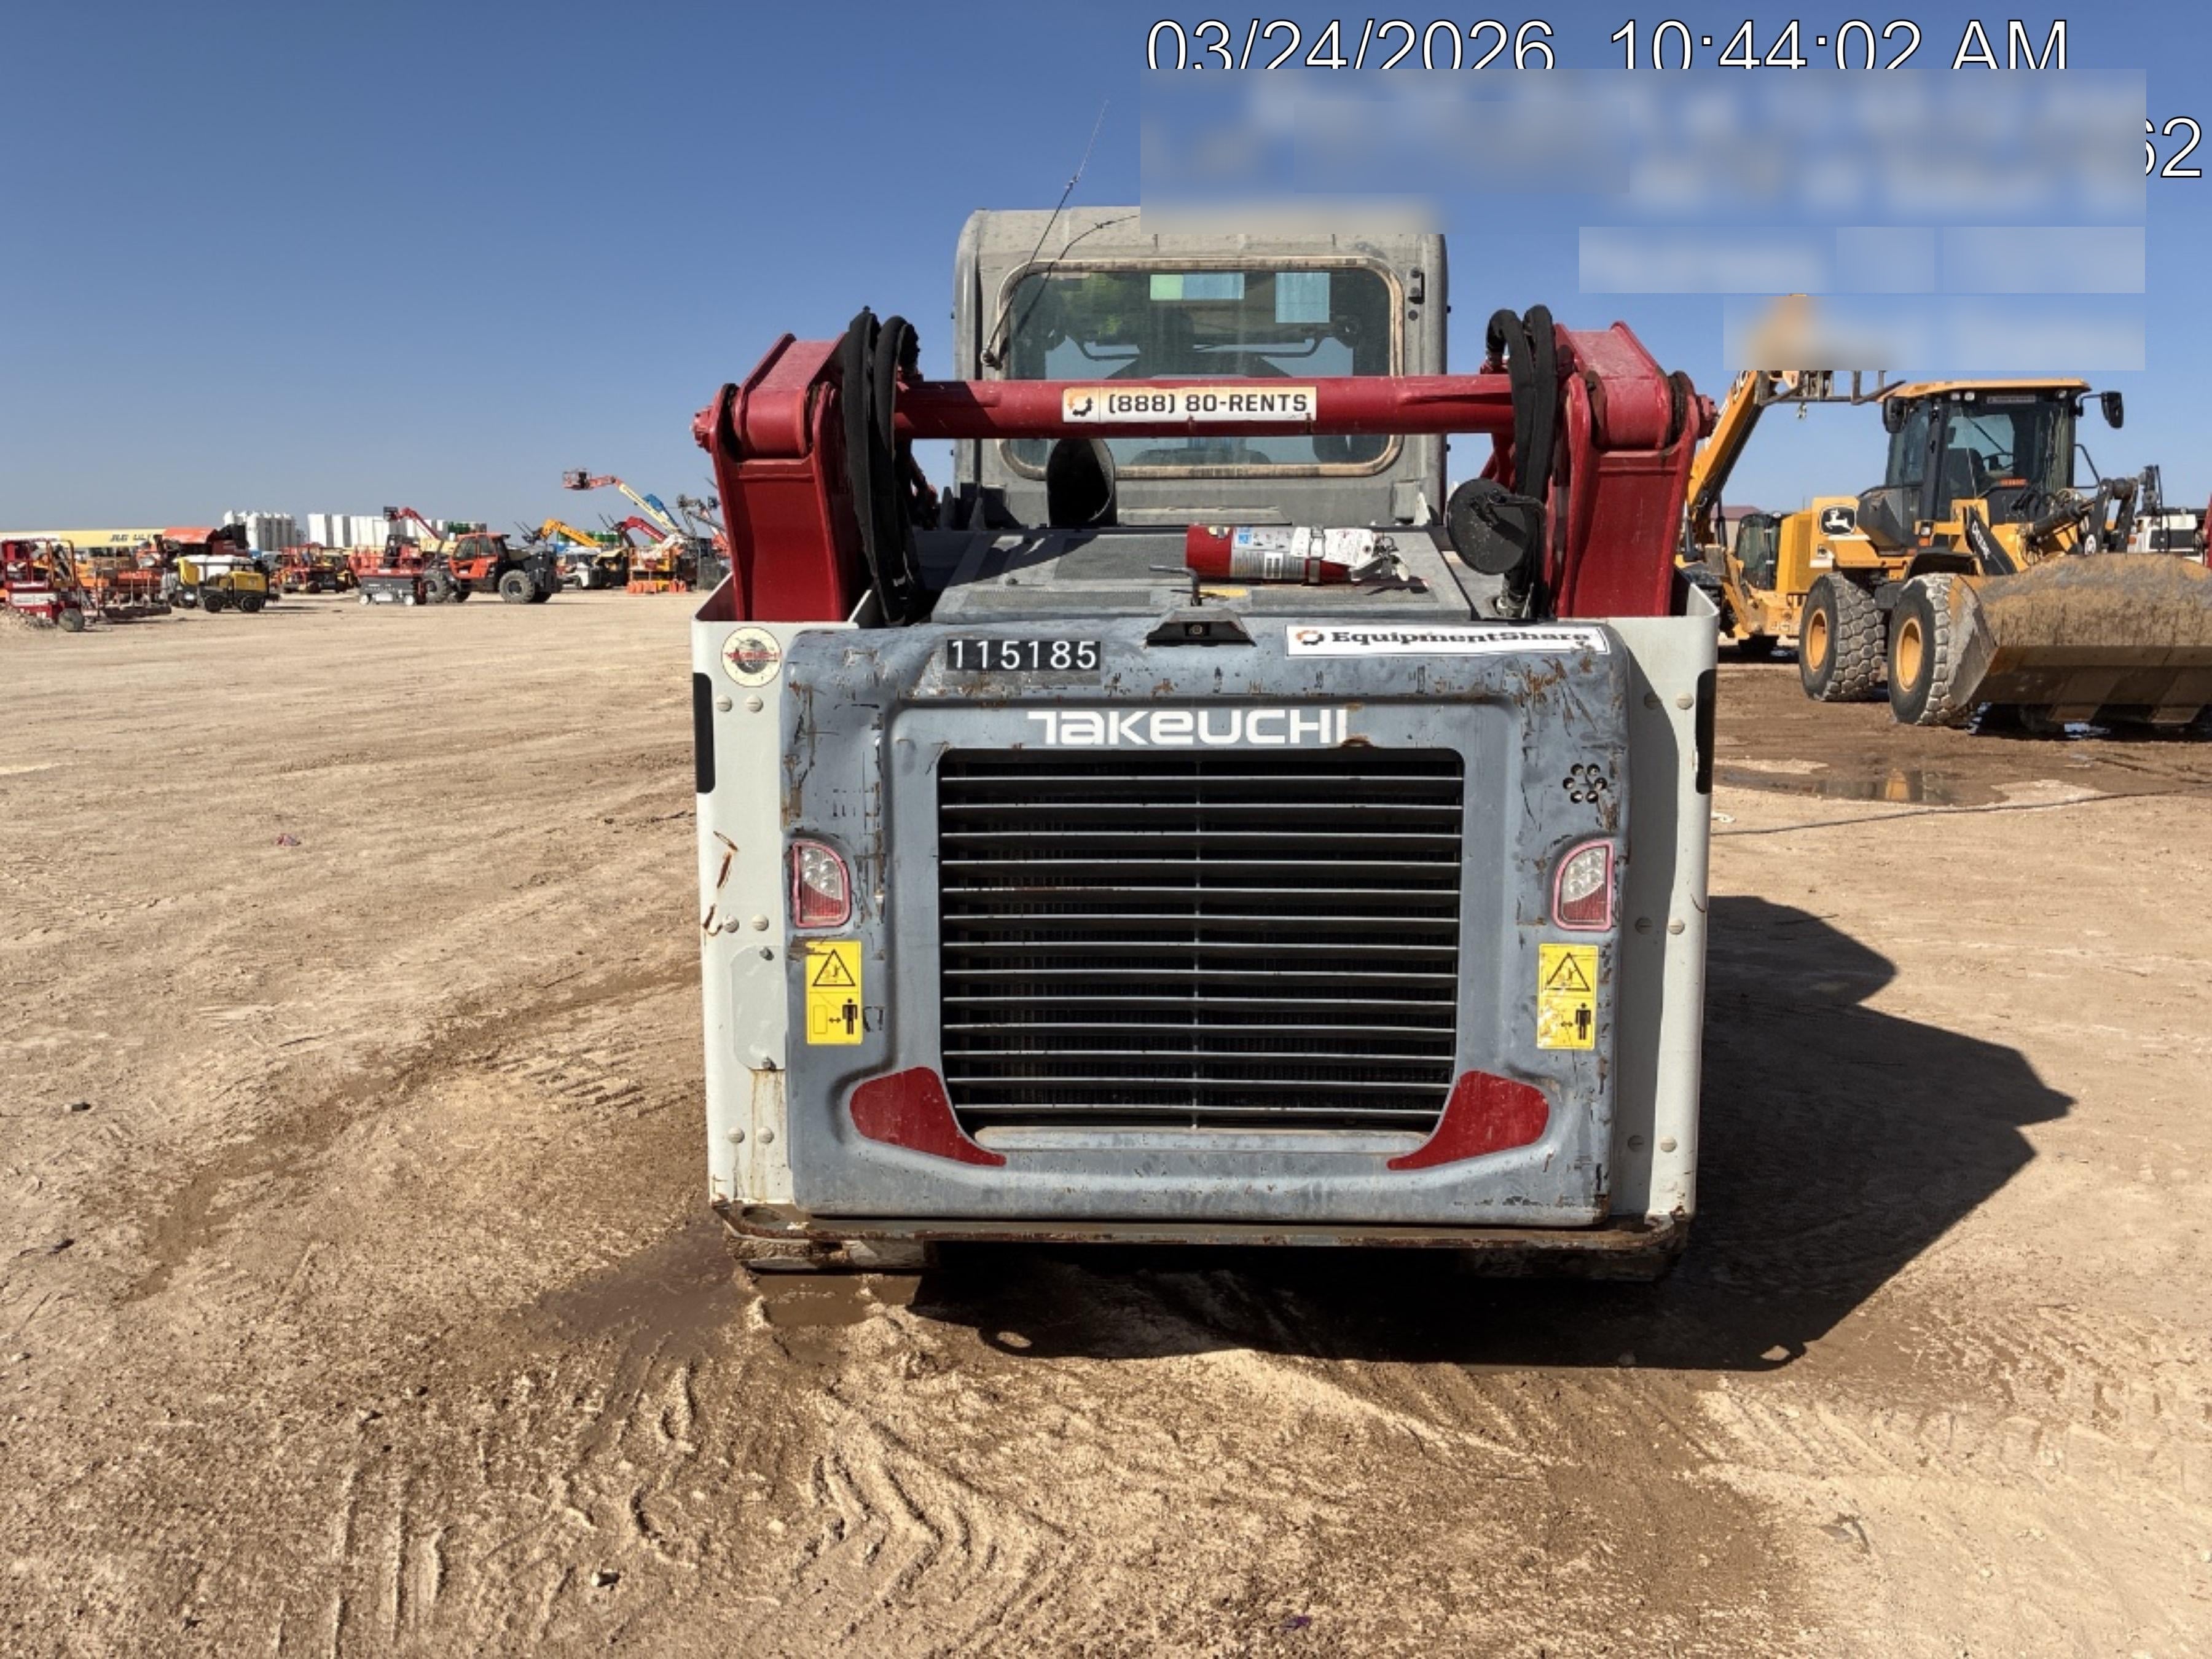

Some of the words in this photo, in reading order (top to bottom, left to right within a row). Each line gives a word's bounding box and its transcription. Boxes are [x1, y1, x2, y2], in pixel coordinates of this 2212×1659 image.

[1108, 394, 1175, 414] (888)
[1186, 394, 1308, 413] 80-RENTS
[1331, 630, 1590, 646] EquipmentShare
[951, 640, 1097, 670] 115185
[1027, 709, 1347, 745] TAKEUCHI
